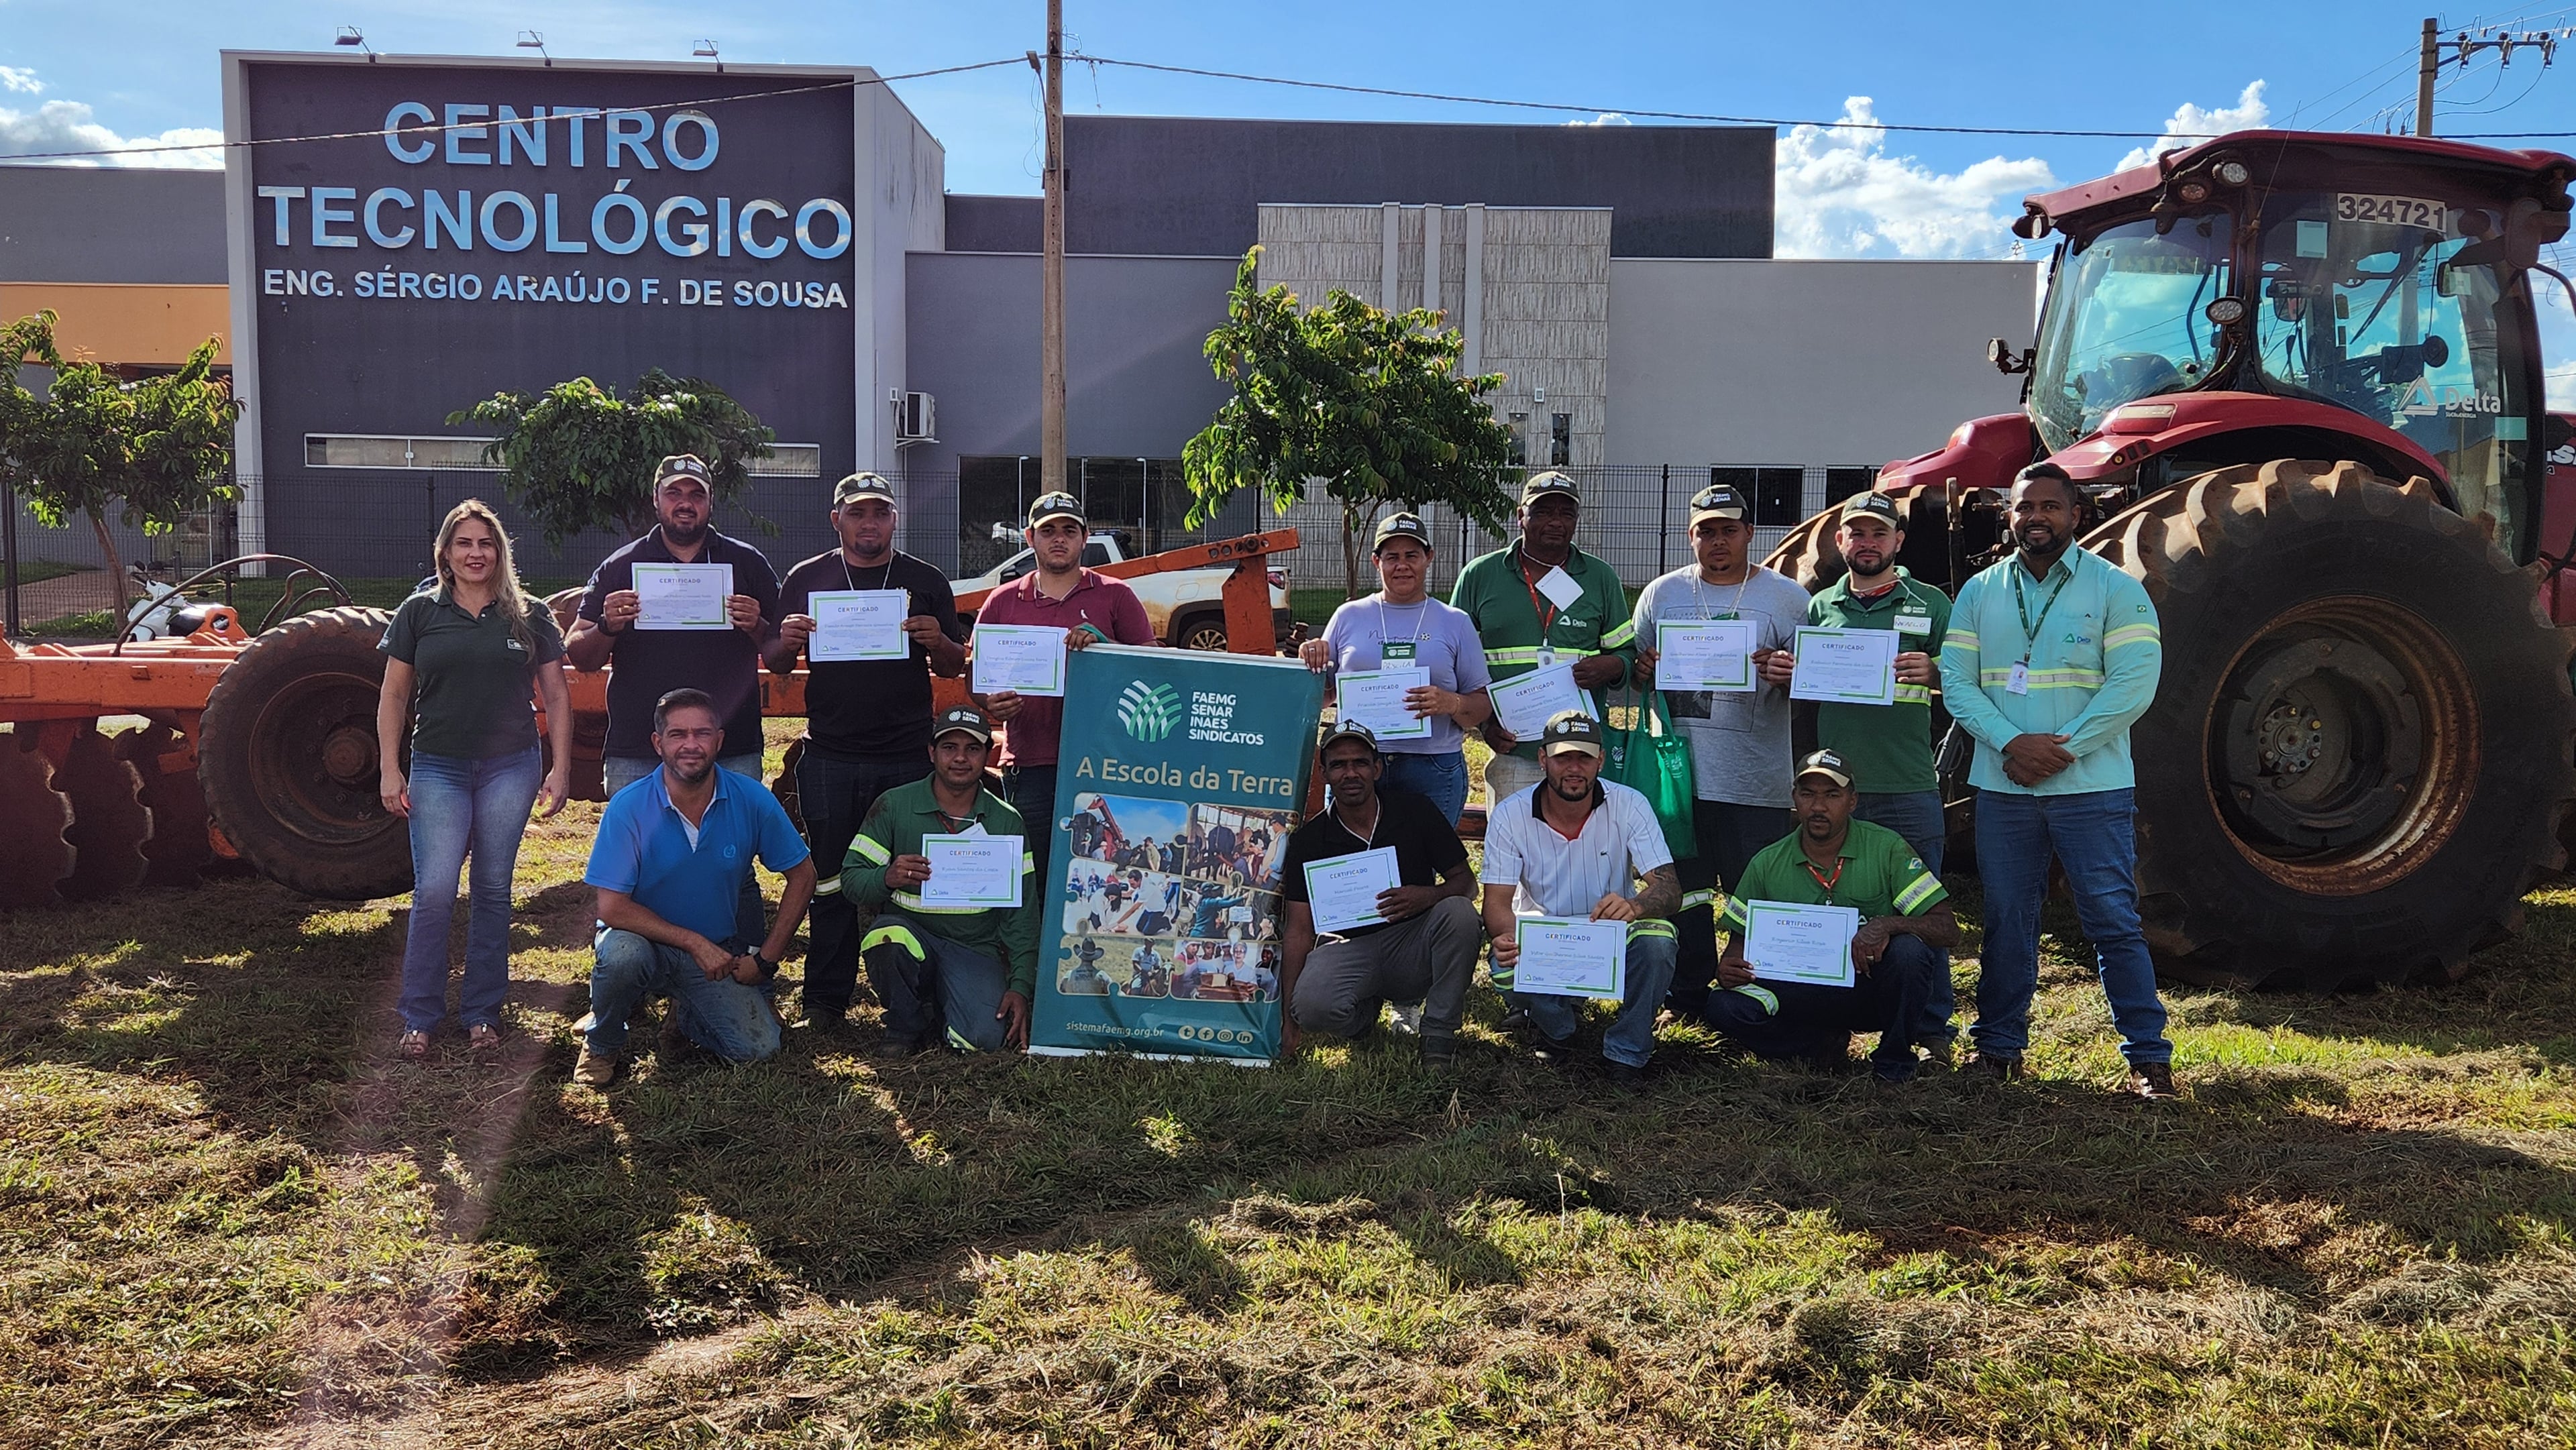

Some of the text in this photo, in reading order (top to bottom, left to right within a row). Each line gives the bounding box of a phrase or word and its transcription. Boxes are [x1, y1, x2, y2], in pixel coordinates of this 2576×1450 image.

[384, 101, 719, 170] CENTRO
[258, 178, 852, 260] TECNOLÓGICO
[2339, 195, 2445, 231] 324721
[264, 264, 848, 308] ENG. SÉRGIO ARAÚJO F. DE SOUSA
[2445, 387, 2501, 413] Delta
[1515, 681, 1555, 697] CERTIFICADO
[1192, 691, 1236, 706] FAEMG
[1191, 704, 1233, 718] SENAR
[1190, 716, 1229, 730] INAES
[1188, 728, 1264, 745] SINDICATOS
[1075, 757, 1293, 796] A Escola da Terra
[1330, 868, 1368, 879] CERTIFICADO
[1776, 919, 1823, 928] CERTIFICADO
[1545, 933, 1591, 941] CERTIFICADO
[1066, 1021, 1165, 1038] sistemafaemg.org.br
